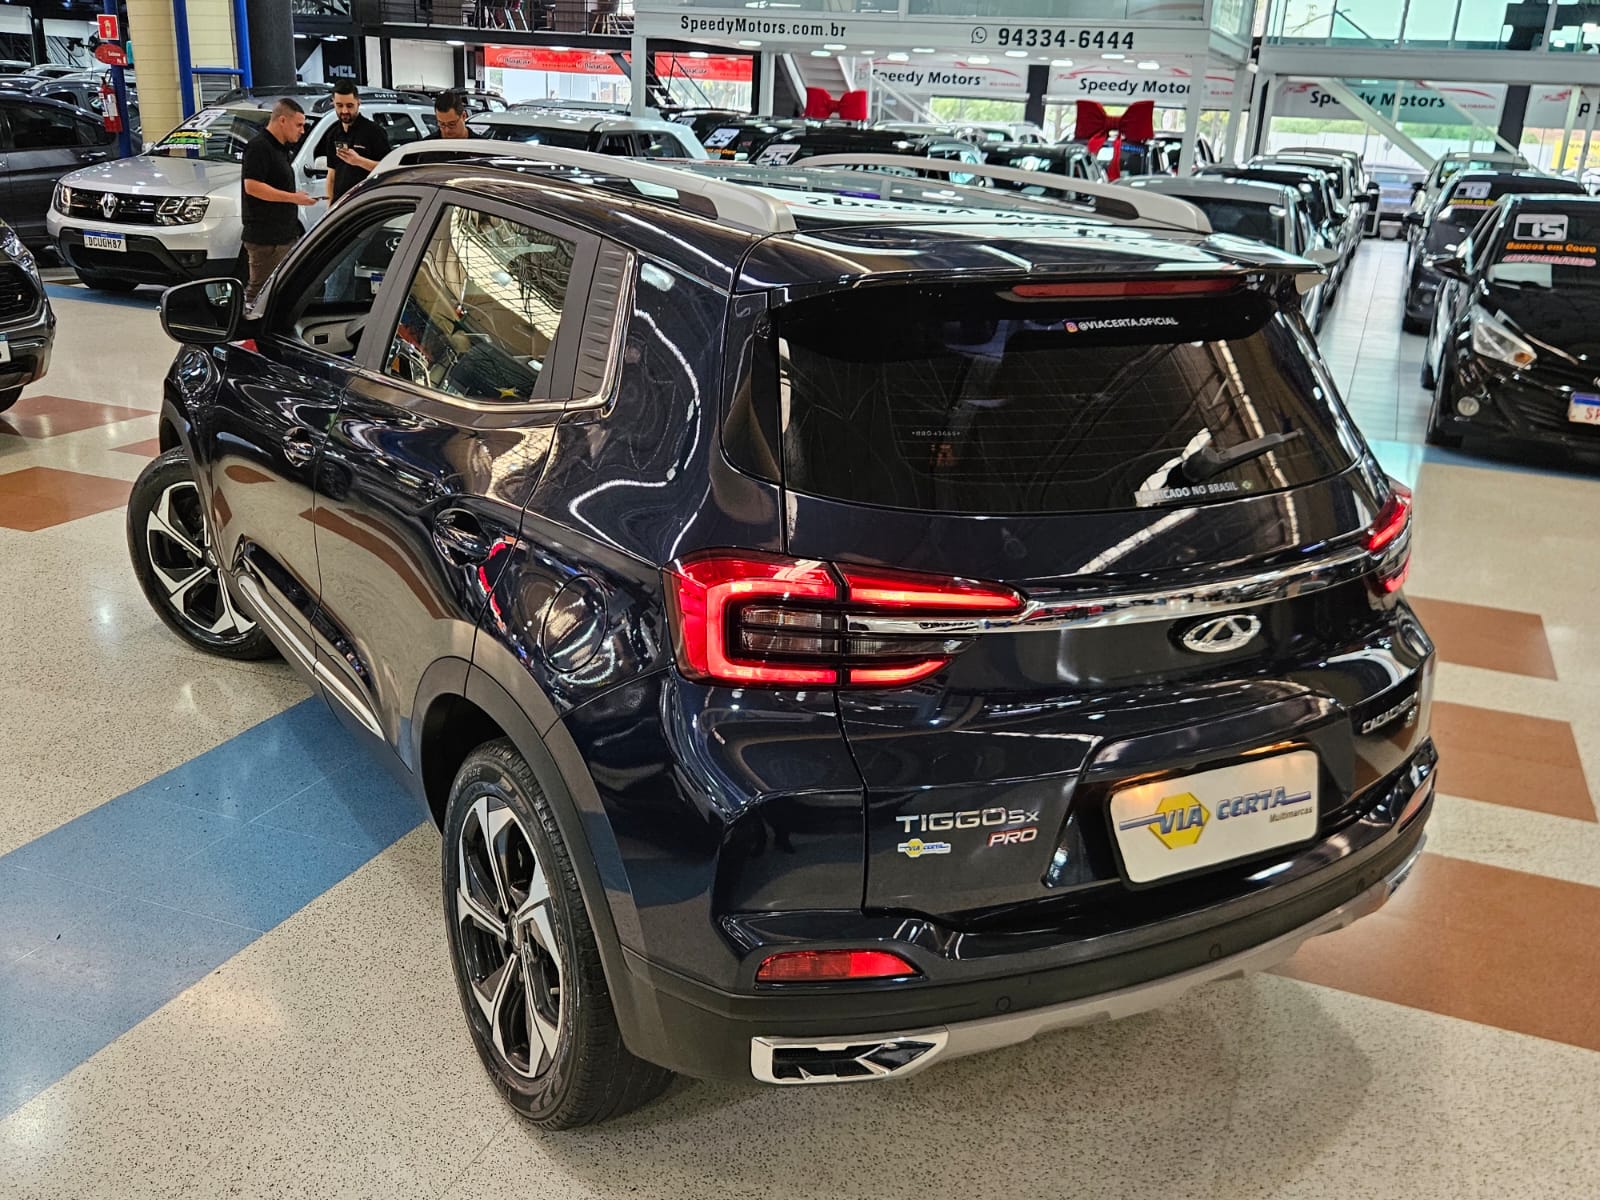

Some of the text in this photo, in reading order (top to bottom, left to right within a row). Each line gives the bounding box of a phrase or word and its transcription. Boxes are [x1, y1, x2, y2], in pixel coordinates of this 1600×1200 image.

[681, 15, 847, 37] SpeedyMotors.com.br
[998, 28, 1134, 50] 94334-6444
[928, 72, 982, 86] Motors
[1079, 77, 1139, 95] Speedy
[1505, 241, 1545, 251] Bancos
[1565, 243, 1597, 253] Couro
[1078, 317, 1179, 331] @VIACERTA.OFICIAL
[1191, 485, 1207, 495] NO
[1207, 481, 1239, 493] BRASIL
[1160, 786, 1288, 835] VIA CERTA
[1269, 806, 1314, 823] Multimarcas
[895, 807, 1006, 833] TIGGO
[987, 828, 1038, 848] PRO
